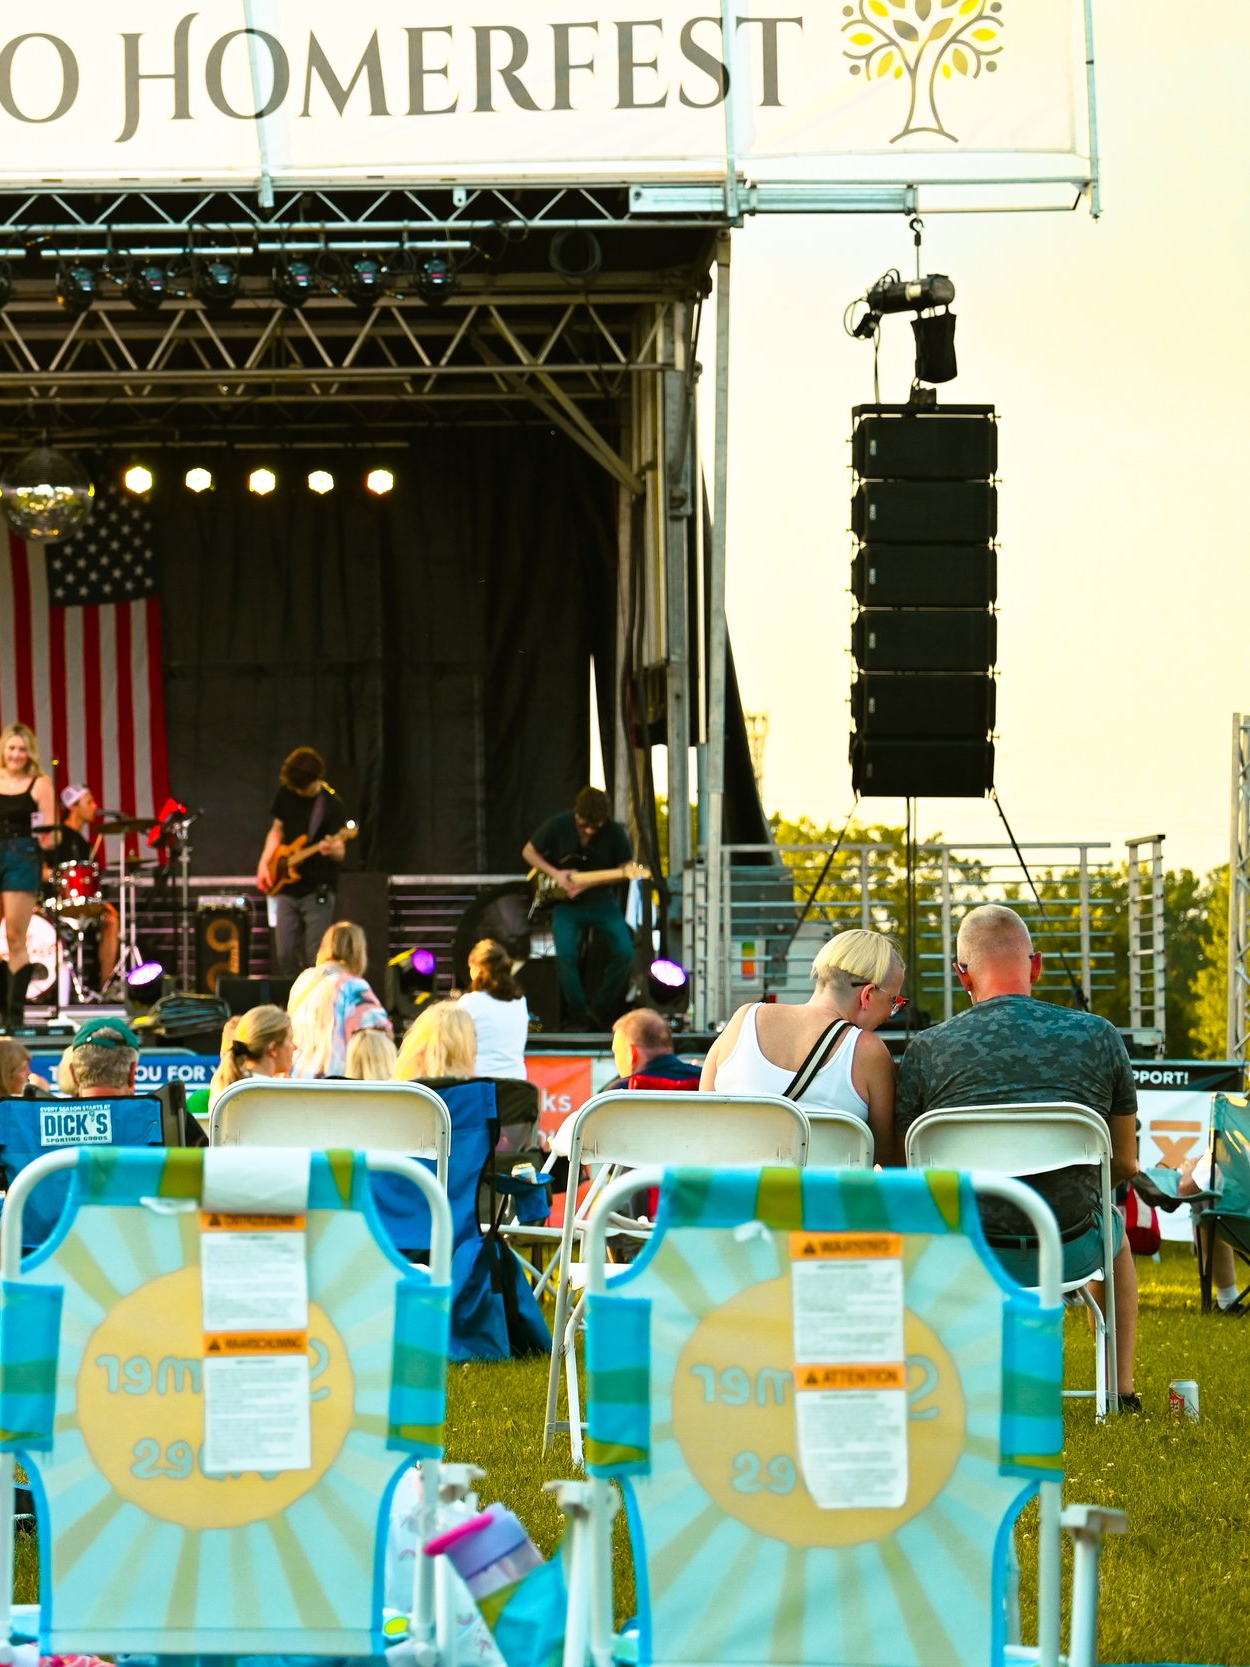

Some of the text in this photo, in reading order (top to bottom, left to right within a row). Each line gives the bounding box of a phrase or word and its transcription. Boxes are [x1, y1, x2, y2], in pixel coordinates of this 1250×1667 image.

[114, 12, 804, 143] HOMERFEST
[135, 1065, 161, 1082] OU
[167, 1065, 205, 1082] FOR
[1132, 1069, 1189, 1085] PPORT!
[44, 1112, 108, 1137] DICK'S
[820, 1239, 890, 1253] WARNING
[822, 1369, 898, 1384] ATTENTION
